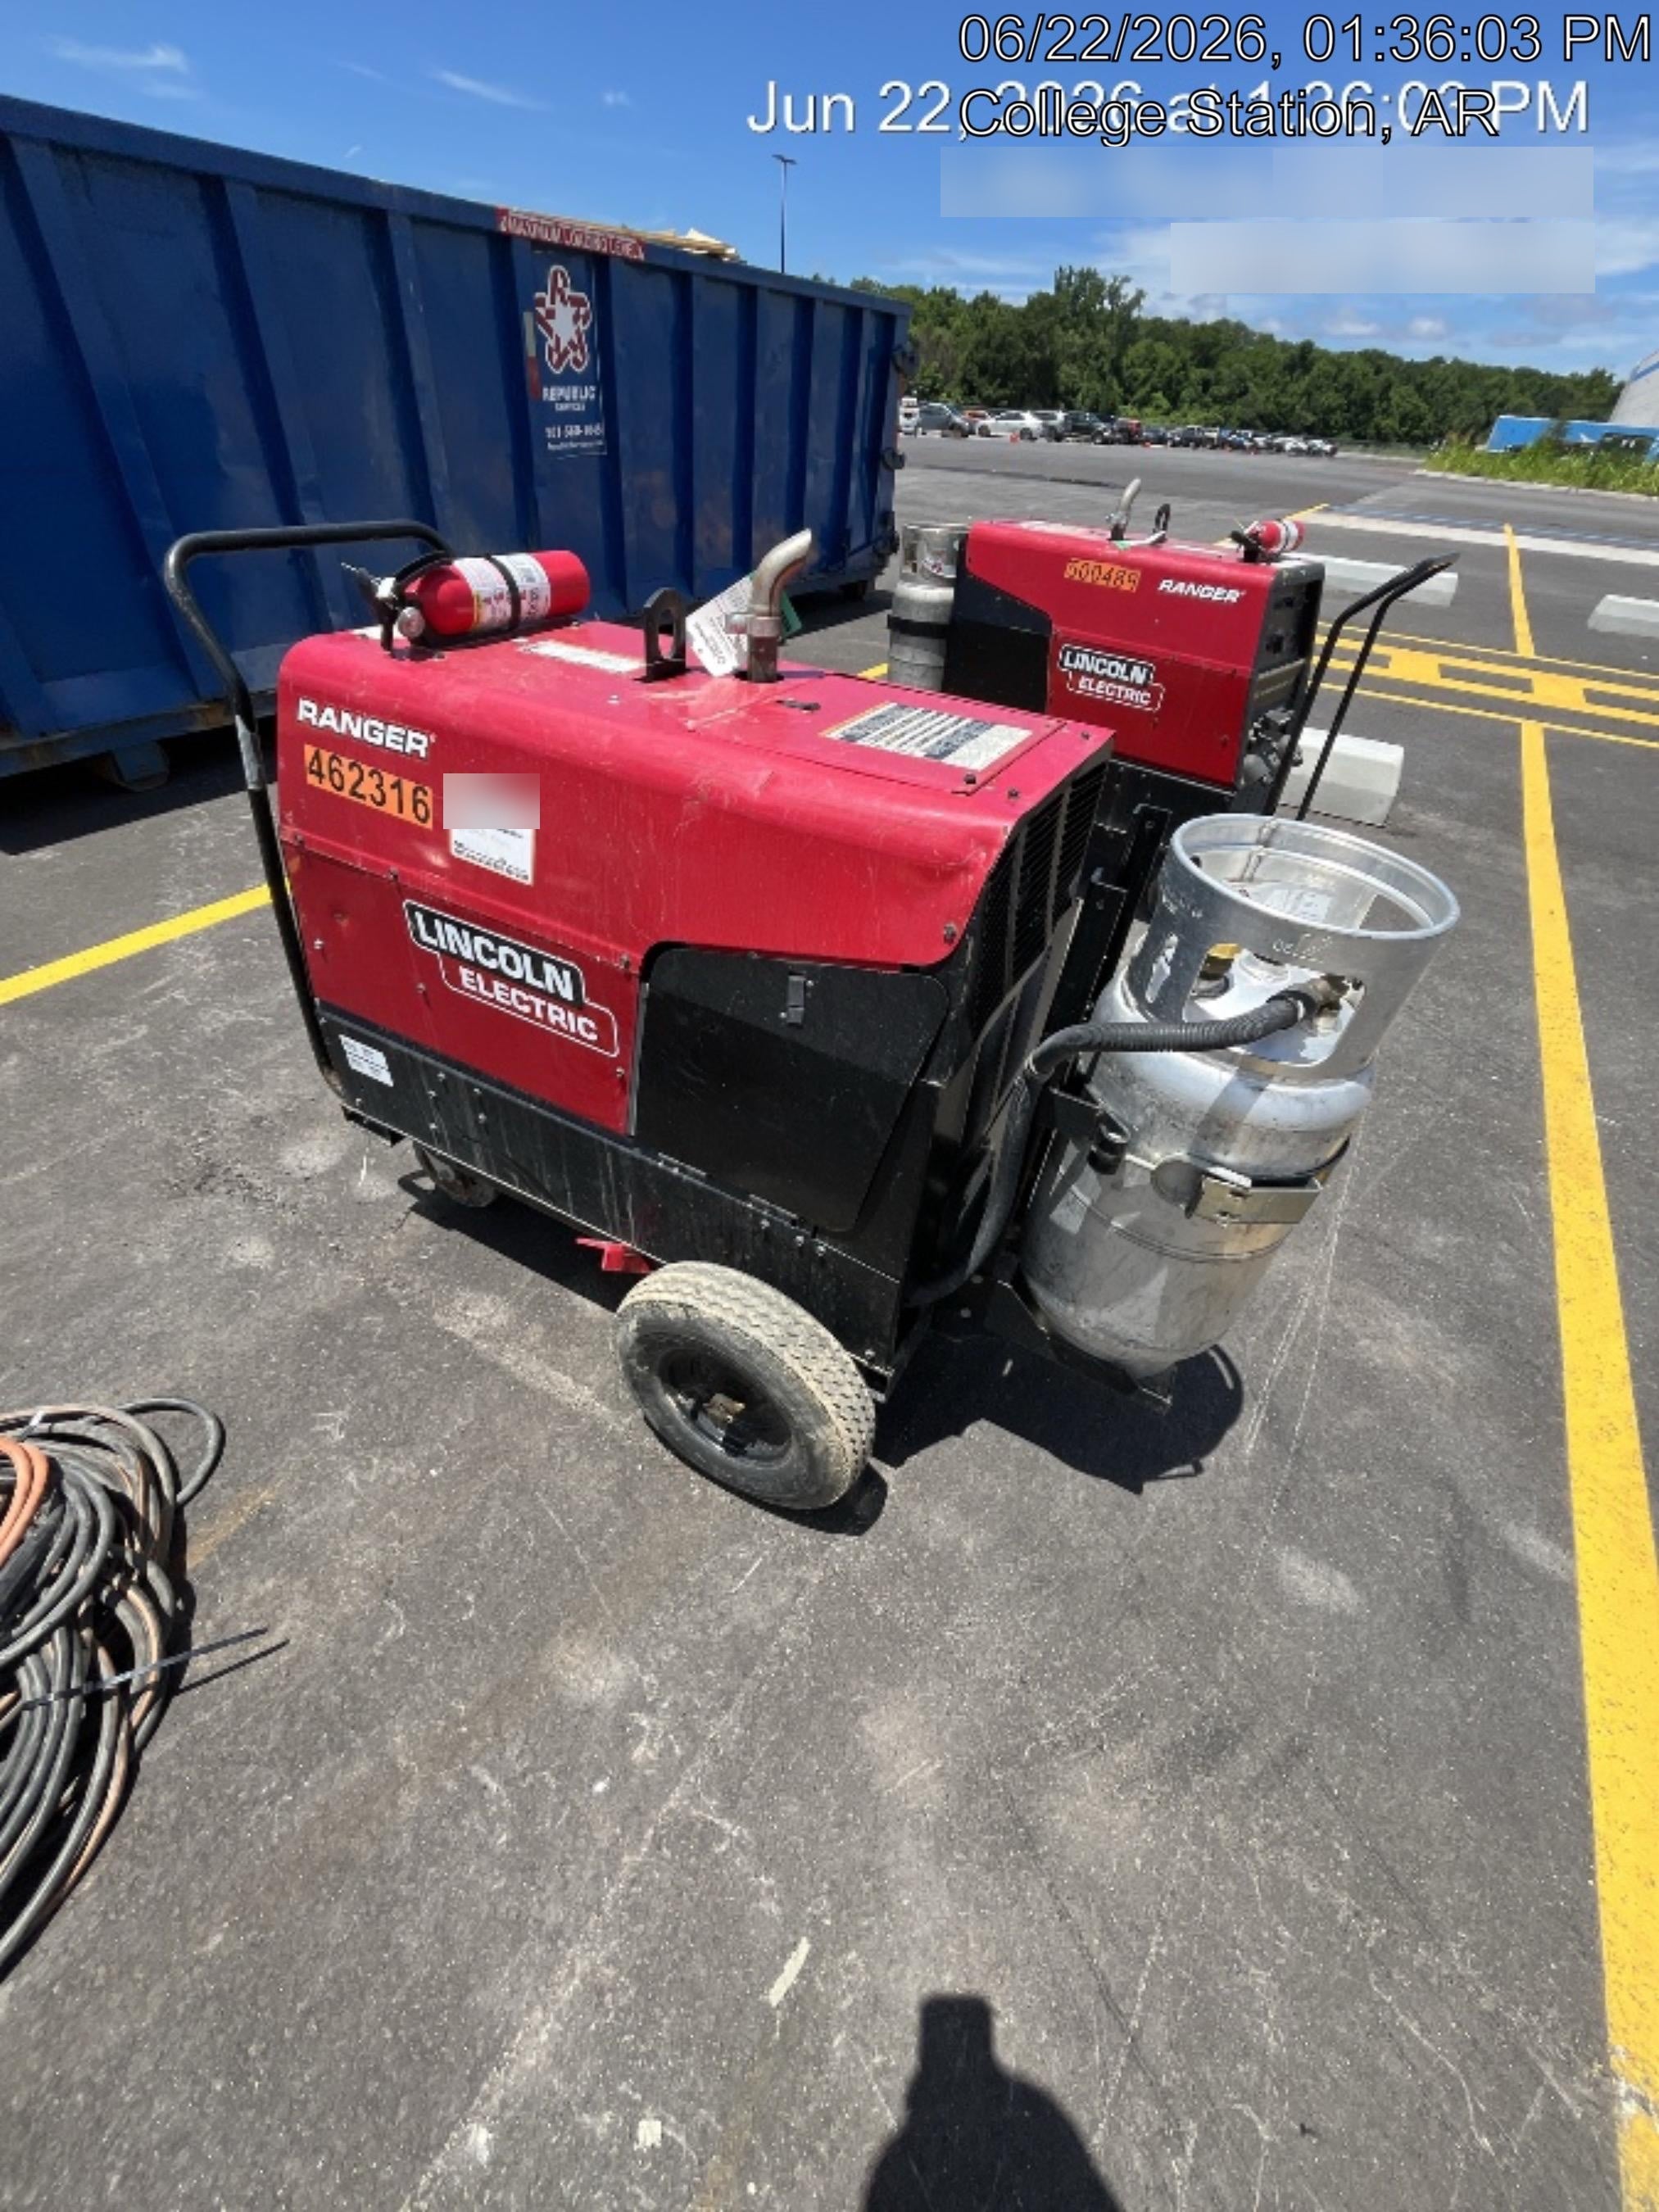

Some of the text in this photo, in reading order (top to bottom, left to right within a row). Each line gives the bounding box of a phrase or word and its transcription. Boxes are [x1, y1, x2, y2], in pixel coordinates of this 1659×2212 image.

[1157, 578, 1243, 604] RANGER
[1064, 650, 1149, 685] LINCOLN
[1077, 677, 1152, 706] ELECTRIC
[297, 697, 429, 759] RANGER
[308, 746, 432, 825] 462316
[415, 910, 575, 1002] LINCOLN
[459, 965, 599, 1042] ELECTRIC
